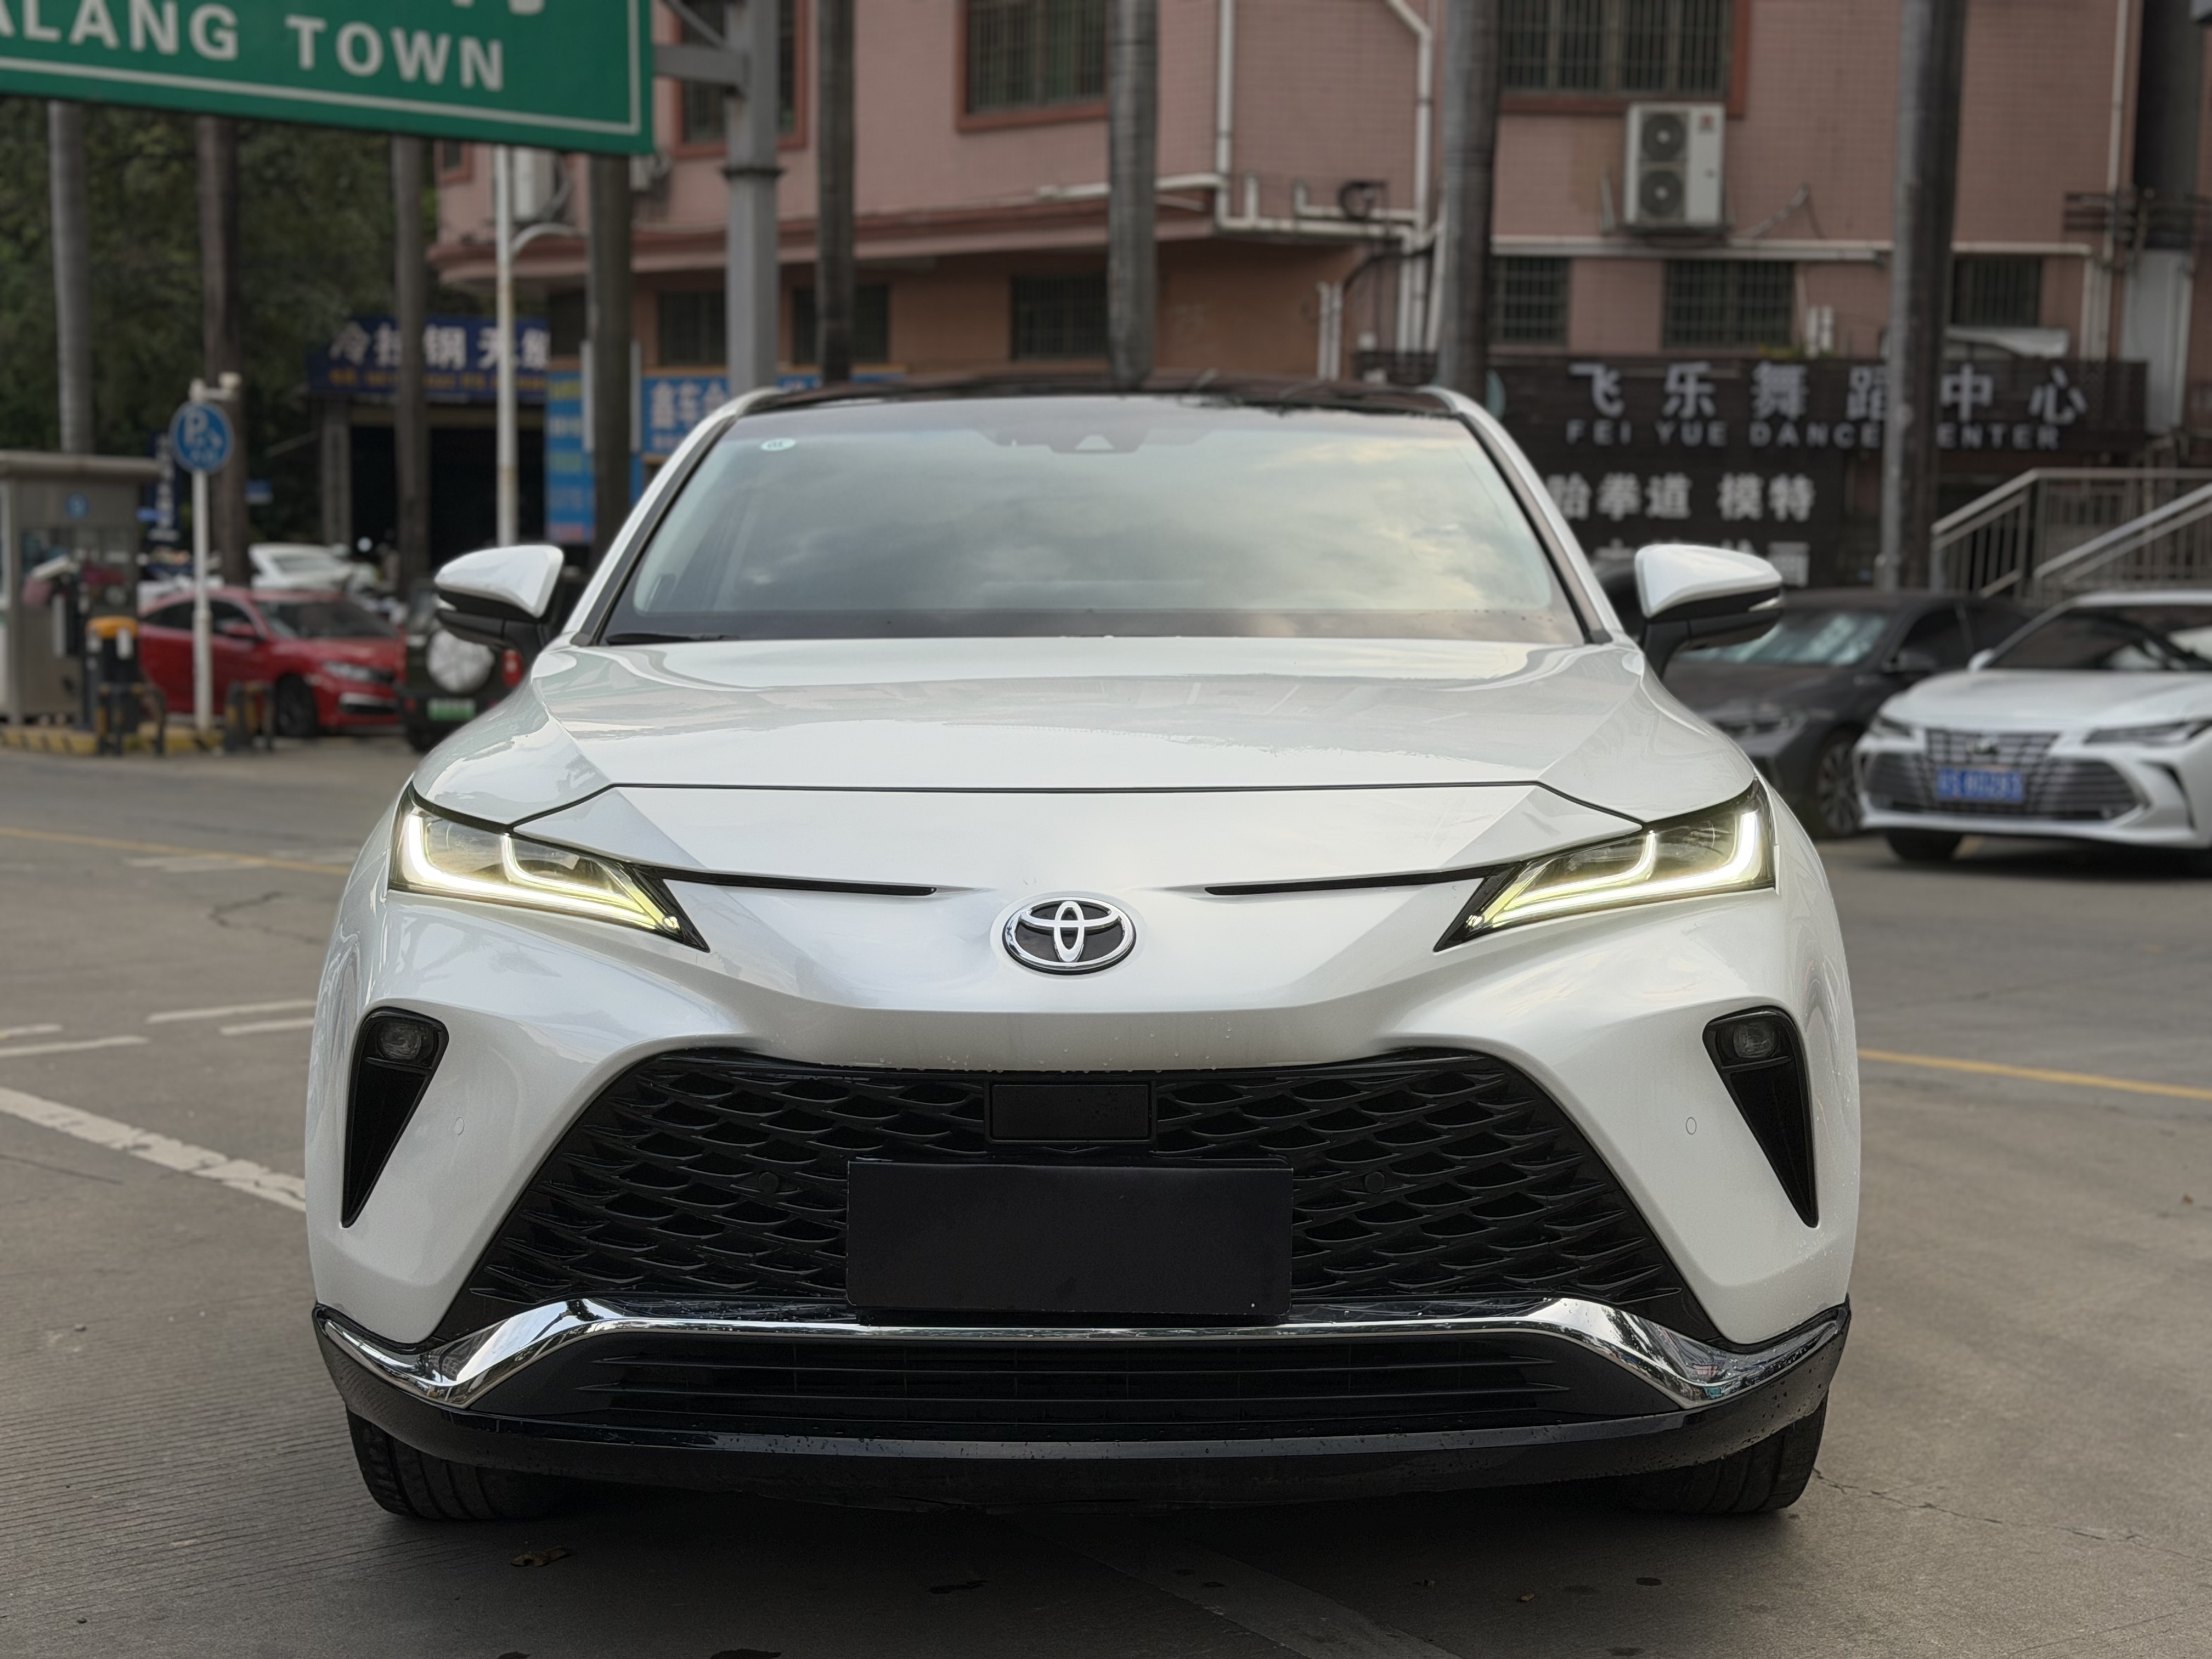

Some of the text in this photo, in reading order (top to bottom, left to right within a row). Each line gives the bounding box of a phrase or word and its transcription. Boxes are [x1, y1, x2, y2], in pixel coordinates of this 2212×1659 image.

[0, 0, 503, 92] LANG TOWN
[1566, 419, 2059, 450] FEI YUE DANCE ENTER
